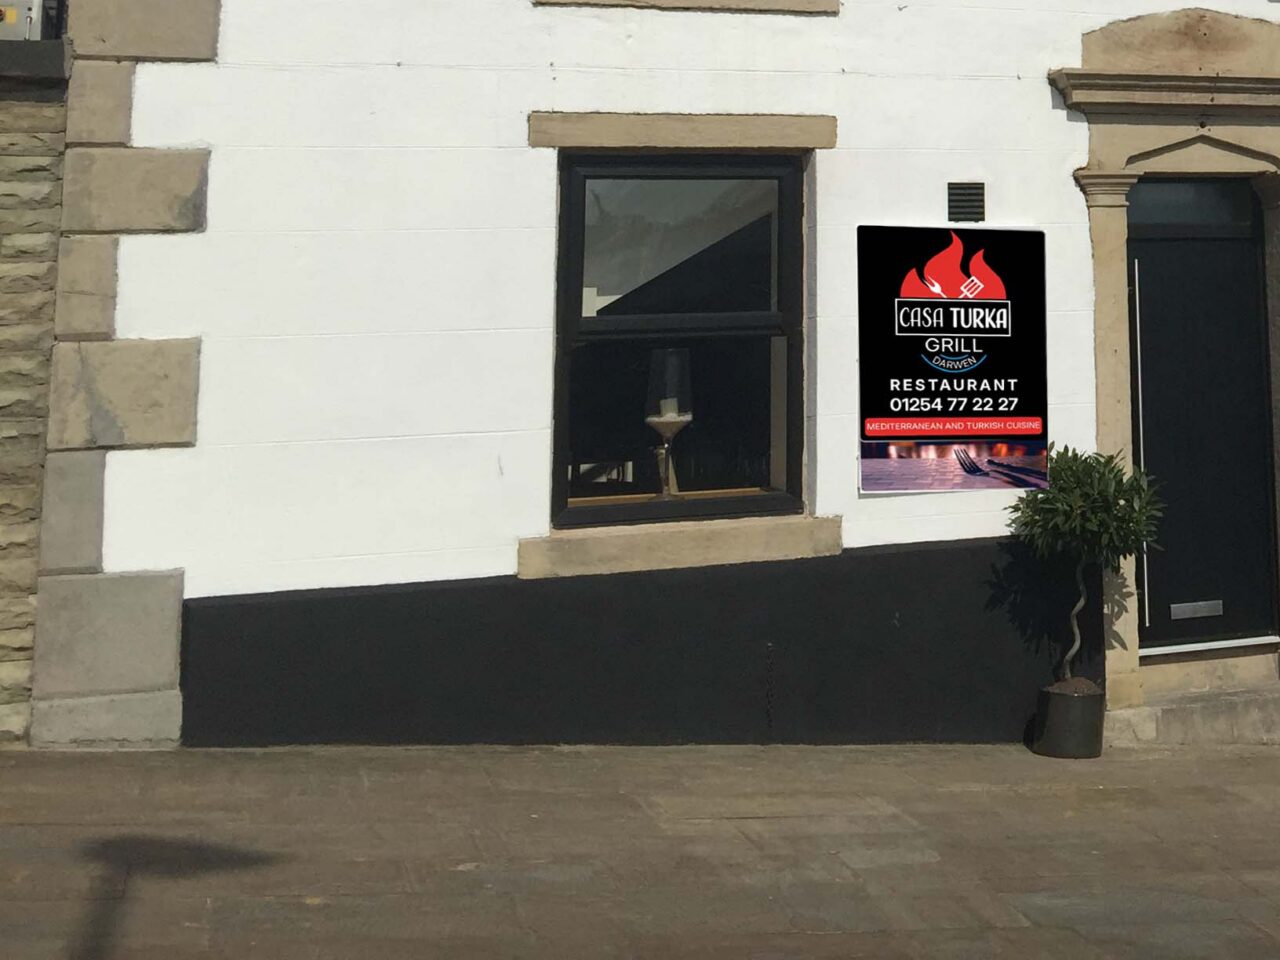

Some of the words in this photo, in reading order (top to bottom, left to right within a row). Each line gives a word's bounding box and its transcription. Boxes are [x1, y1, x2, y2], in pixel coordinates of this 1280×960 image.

[899, 307, 944, 328] CASA
[949, 307, 1007, 329] TURKA
[925, 338, 983, 352] GRILL
[932, 355, 977, 370] DARWEN
[890, 379, 1018, 391] RESTAURANT
[890, 397, 943, 412] 01254
[947, 397, 968, 412] 77
[972, 397, 994, 411] 22
[998, 397, 1019, 411] 27
[866, 422, 944, 431] MEDITERRANEAN
[945, 422, 965, 430] AND
[966, 421, 1004, 430] TURKISH
[1006, 420, 1041, 429] CUISINE
